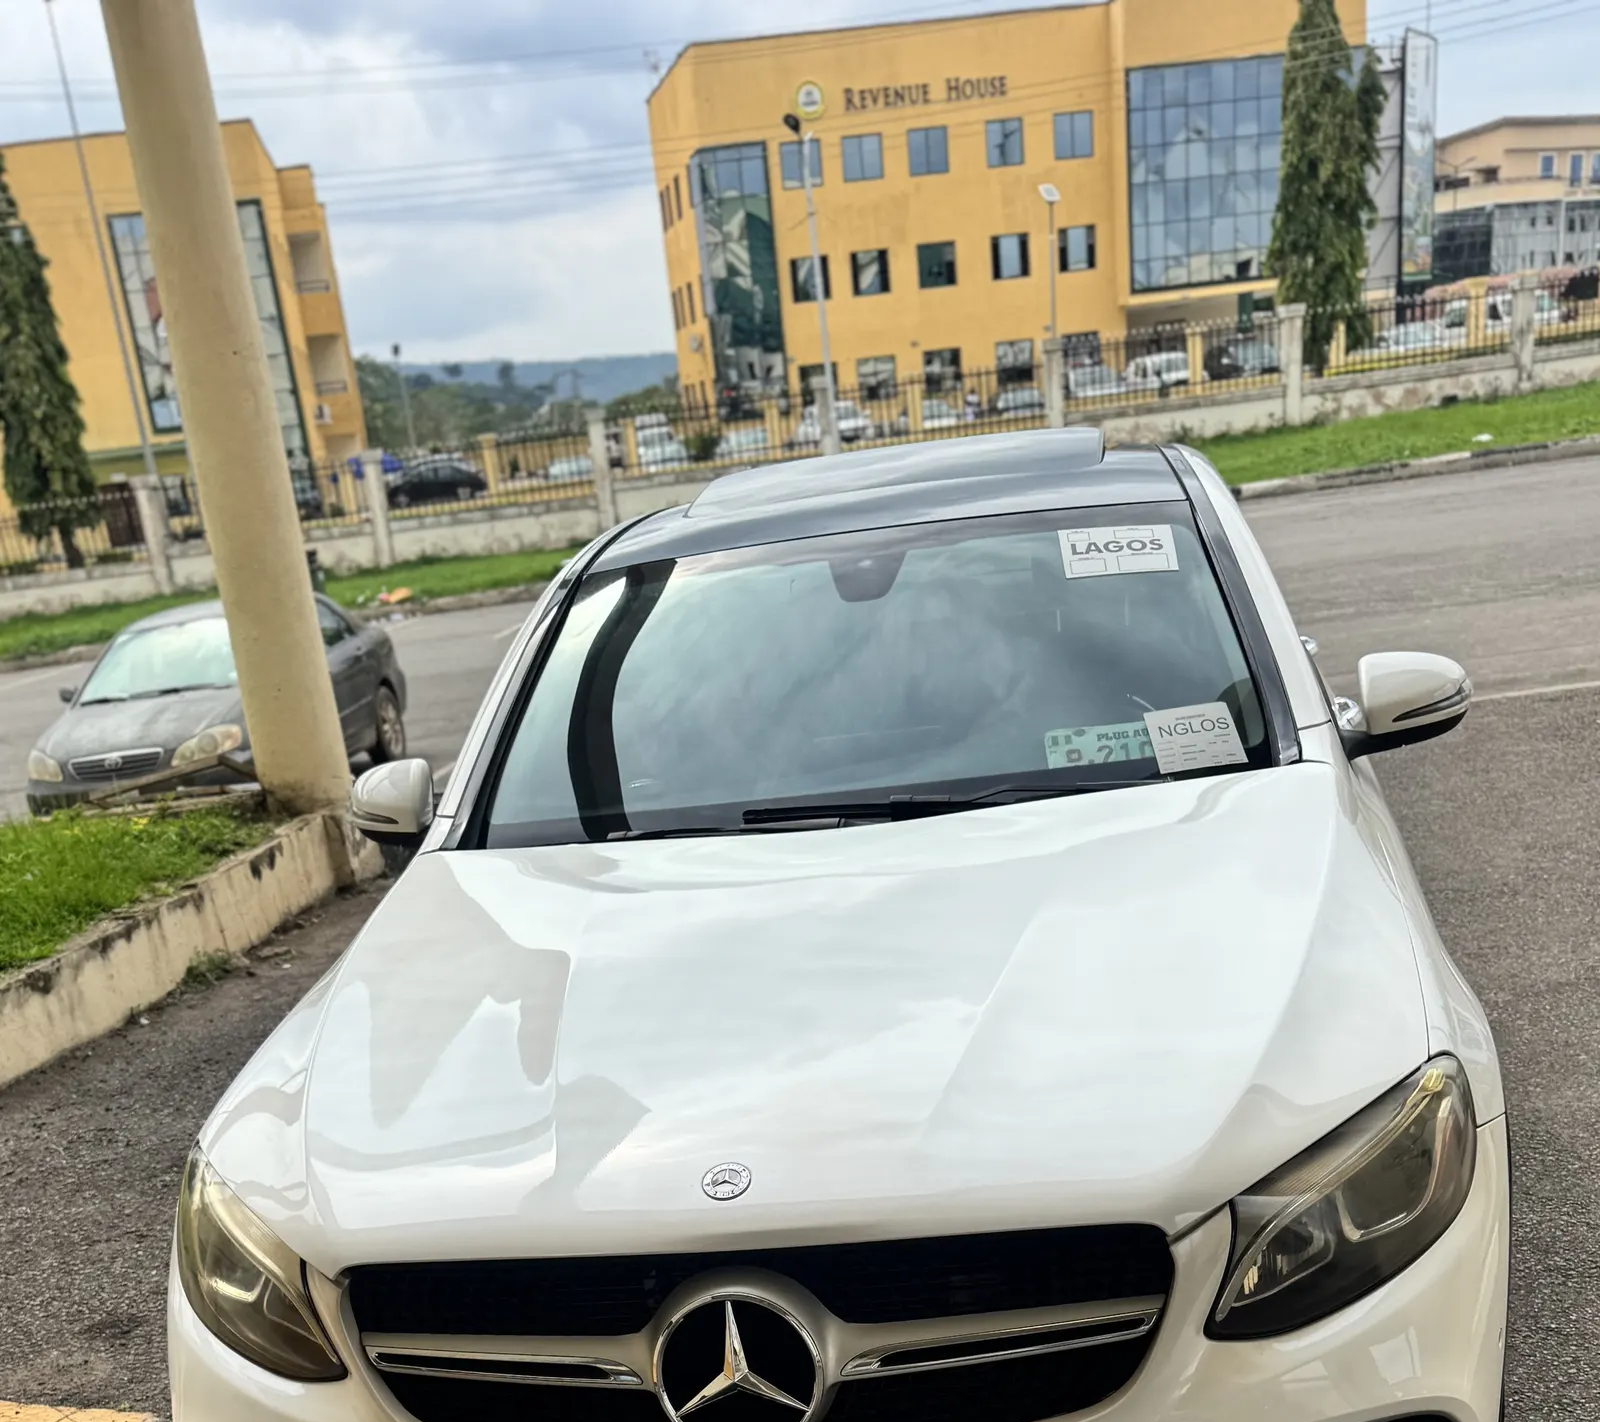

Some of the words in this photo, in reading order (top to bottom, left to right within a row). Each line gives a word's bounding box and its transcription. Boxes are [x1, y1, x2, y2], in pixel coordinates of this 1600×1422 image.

[843, 83, 931, 112] REVENUE
[945, 75, 1008, 102] HOUSE
[1070, 538, 1164, 556] LAGOS
[1096, 730, 1130, 742] PLUG
[1158, 717, 1230, 738] NGLOS
